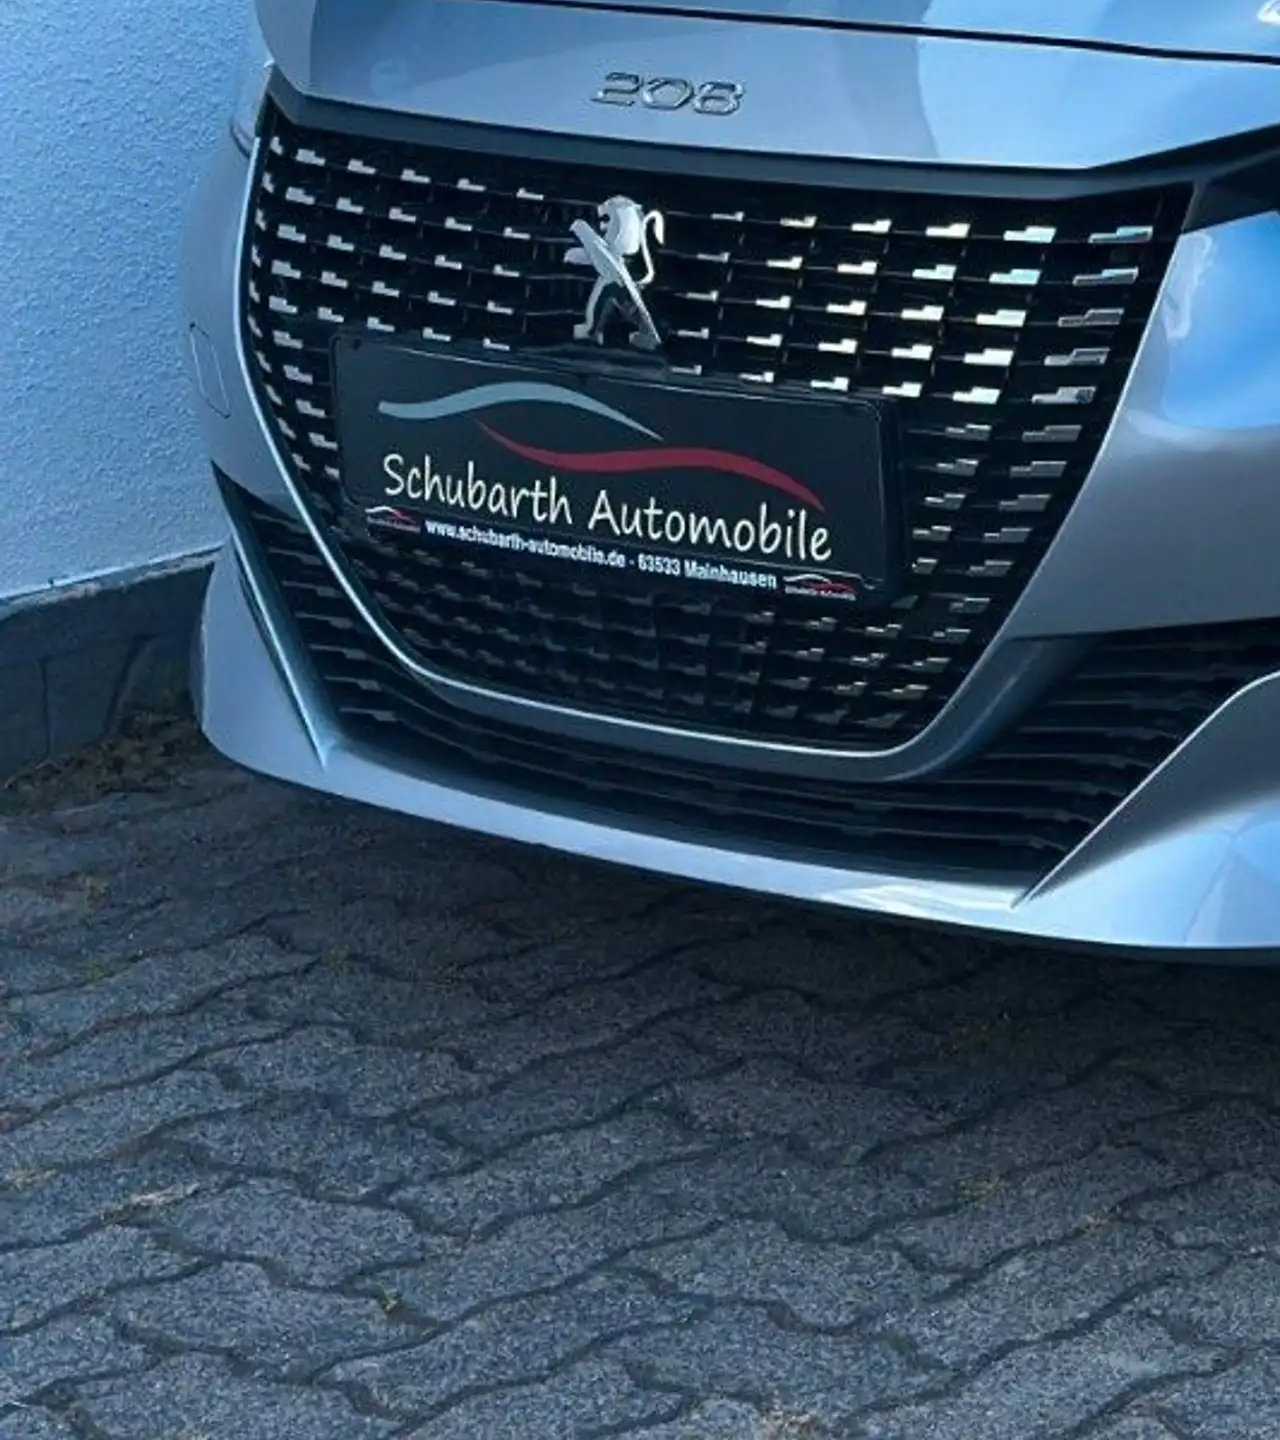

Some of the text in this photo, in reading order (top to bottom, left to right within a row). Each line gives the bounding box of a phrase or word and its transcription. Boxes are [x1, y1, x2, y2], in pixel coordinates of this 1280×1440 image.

[590, 71, 745, 116] 208
[382, 453, 832, 561] Schubarth Automobile
[637, 553, 681, 577] 63533
[683, 559, 778, 590] Mainhausen
